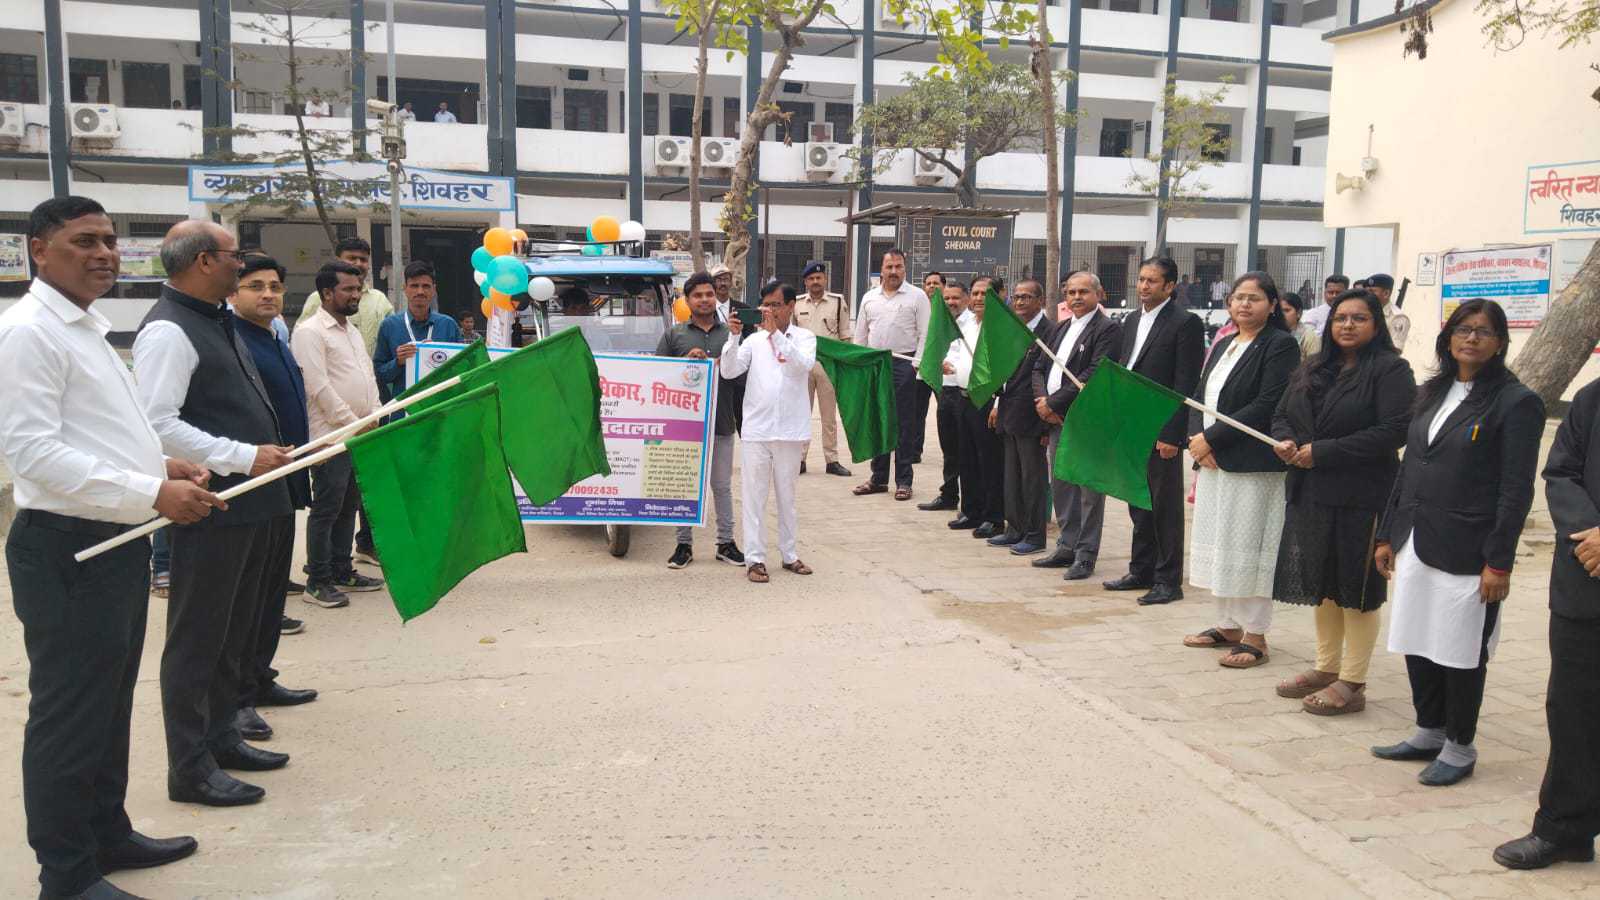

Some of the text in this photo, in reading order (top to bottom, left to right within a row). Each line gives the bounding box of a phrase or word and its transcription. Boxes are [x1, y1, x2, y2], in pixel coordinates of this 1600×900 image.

[408, 174, 493, 201] शिवहर
[1530, 170, 1575, 204] त्वरित
[942, 225, 998, 238] CIVIL COURT
[652, 382, 701, 412] शिवहर
[568, 486, 619, 496] 70092435
